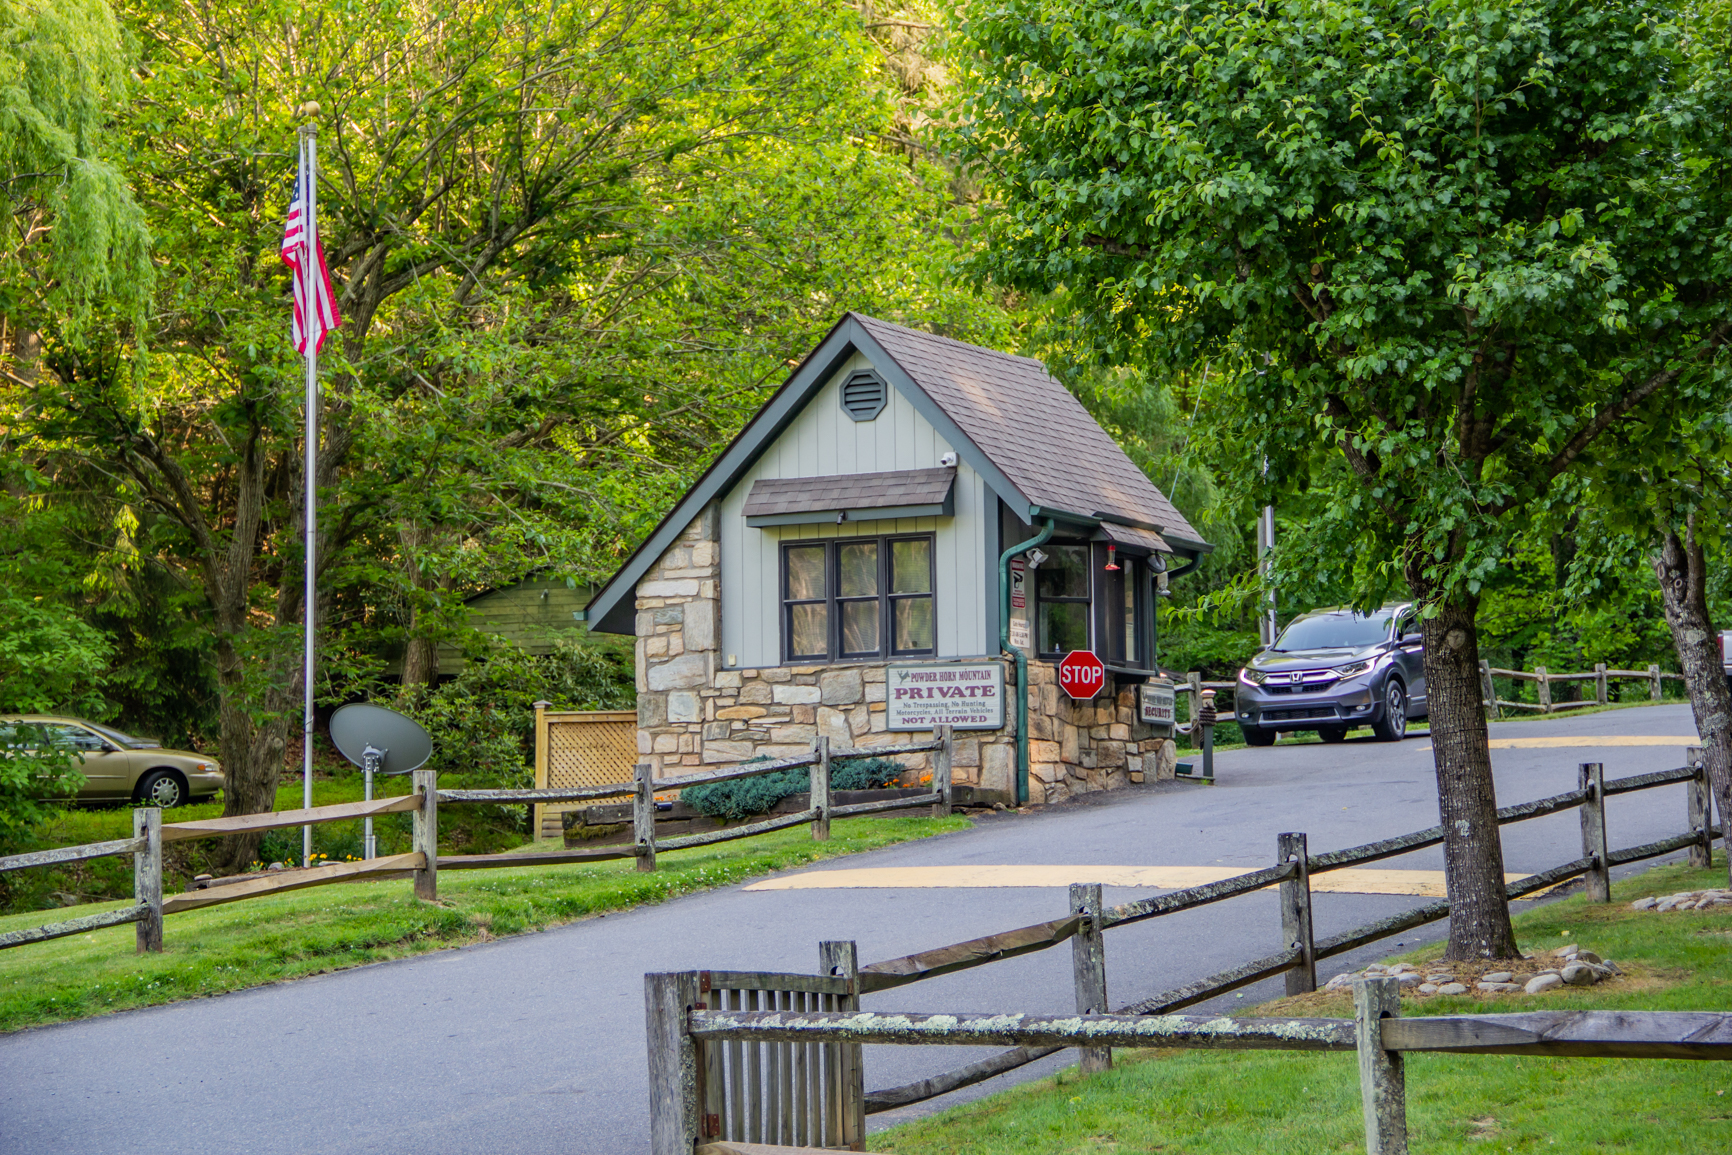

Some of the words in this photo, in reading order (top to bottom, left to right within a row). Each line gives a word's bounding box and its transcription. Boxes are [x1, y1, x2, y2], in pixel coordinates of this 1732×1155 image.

[910, 672, 938, 682] POWDER
[939, 671, 957, 682] HORN
[958, 670, 992, 680] MOUNTAIN
[1062, 665, 1102, 684] STOP
[894, 685, 996, 700] PRIVATE
[912, 701, 950, 709] Trespassing,
[961, 700, 986, 708] Hunting
[896, 709, 933, 717] Motorcycles,
[1144, 705, 1171, 719] SECURITY
[902, 716, 926, 725] NOT
[929, 715, 988, 724] ALLOWED
